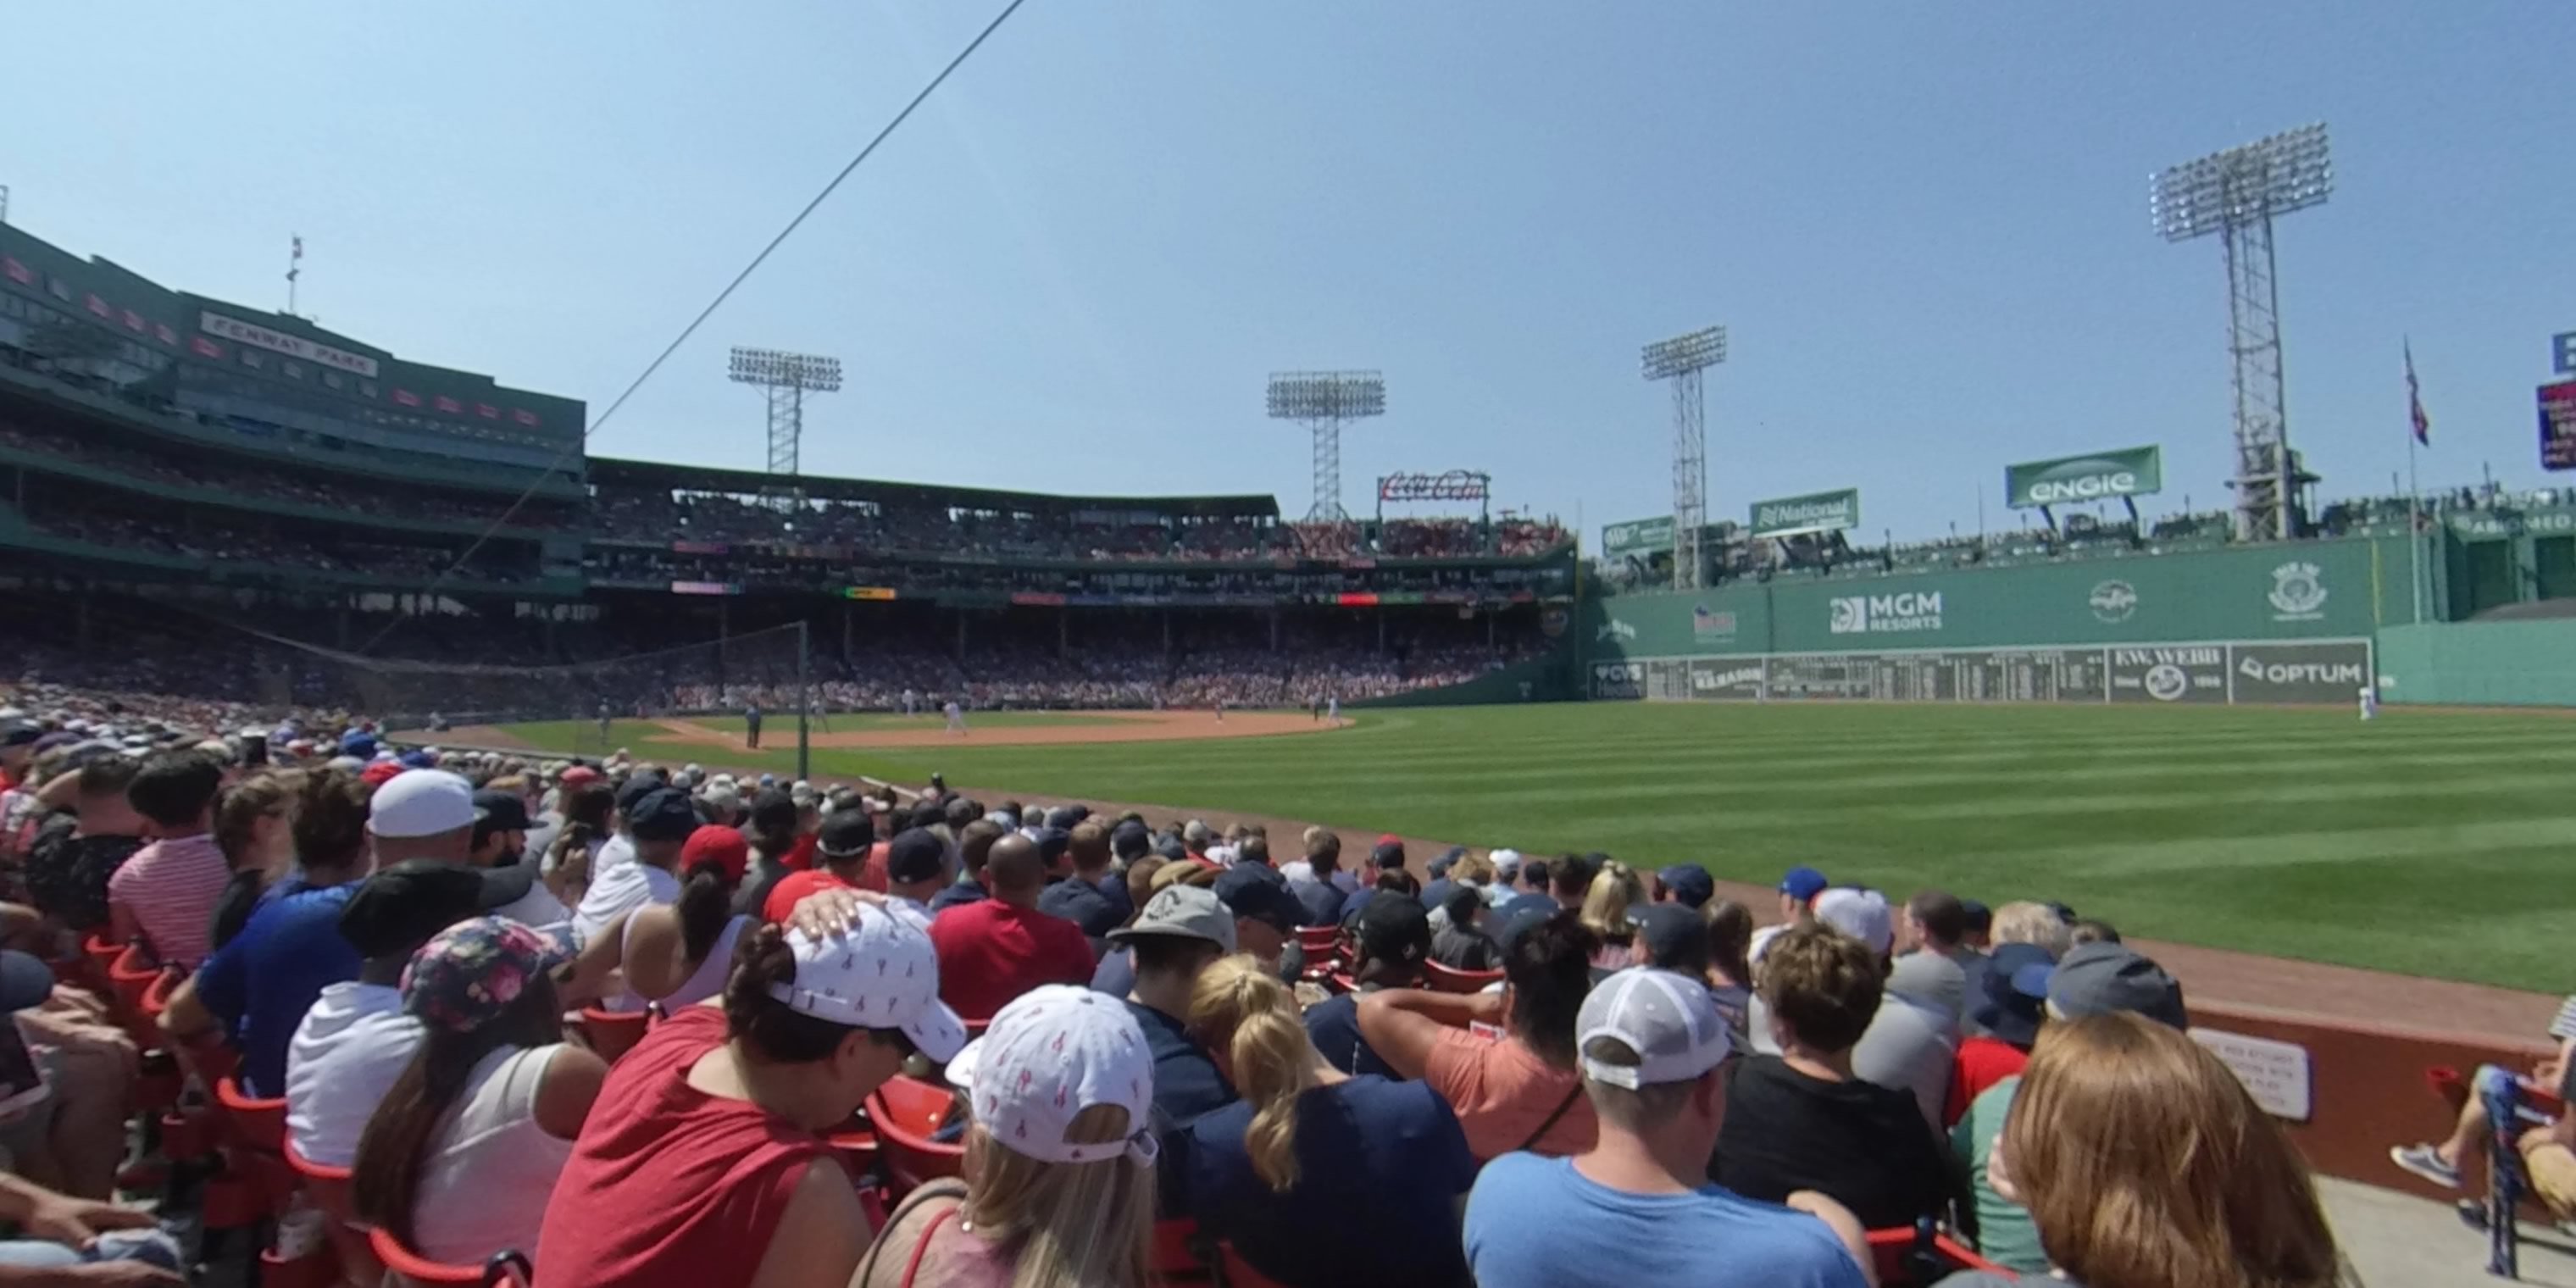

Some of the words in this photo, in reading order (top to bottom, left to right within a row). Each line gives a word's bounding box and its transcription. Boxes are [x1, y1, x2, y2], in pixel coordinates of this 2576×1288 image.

[214, 319, 301, 353] FENWAY
[316, 347, 368, 371] PARK
[1779, 497, 1848, 522] National
[1869, 591, 1941, 618] MGM
[1870, 616, 1942, 631] RESORTS
[2155, 648, 2220, 665] WEBB
[1610, 663, 1642, 681] CVS
[2267, 663, 2362, 683] OPTUM
